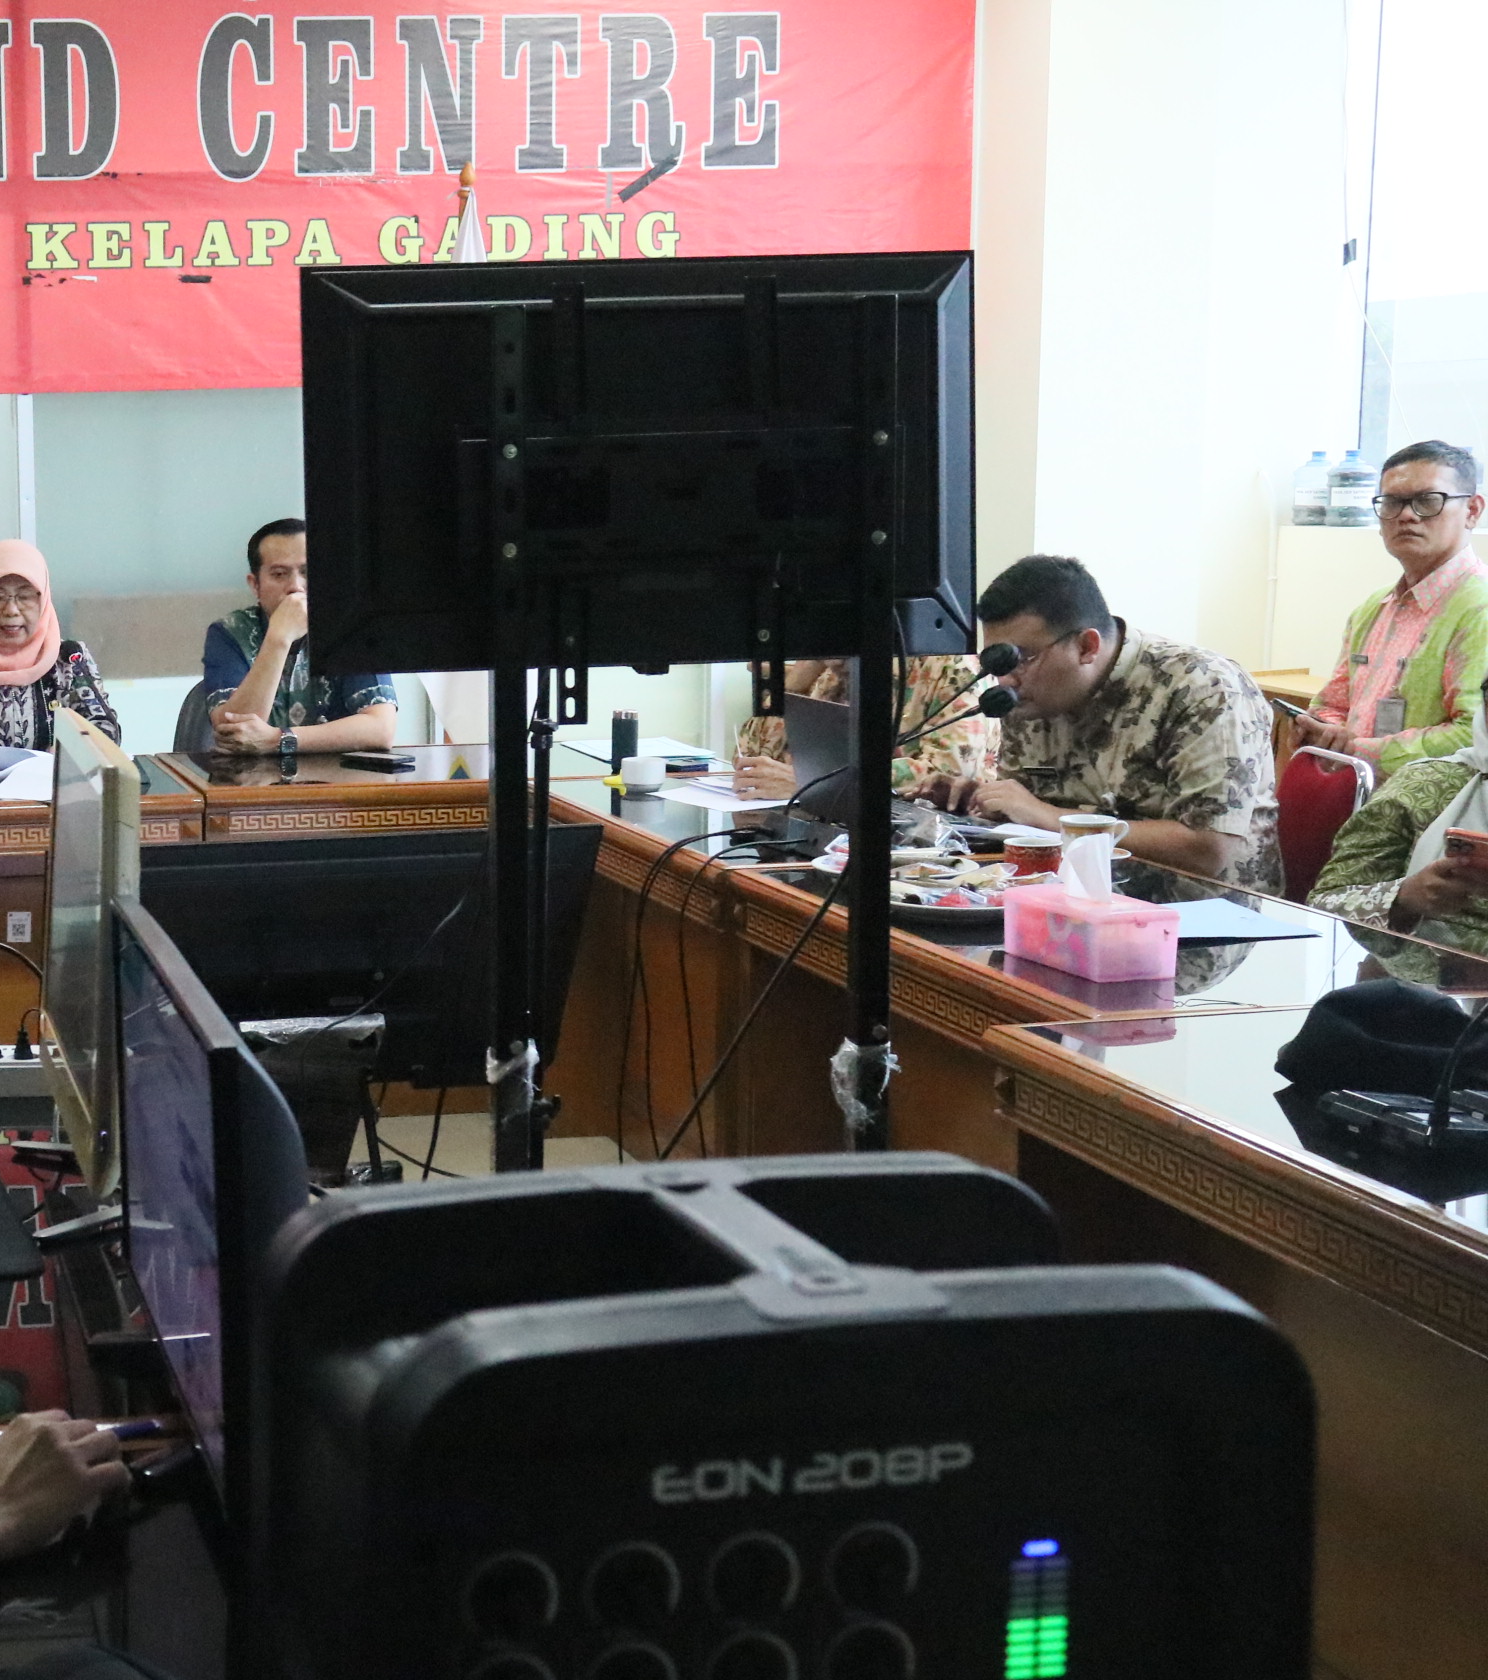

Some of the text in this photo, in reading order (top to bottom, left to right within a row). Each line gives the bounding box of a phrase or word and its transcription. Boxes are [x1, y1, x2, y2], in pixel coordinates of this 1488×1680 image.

[197, 10, 783, 184] CENTRE
[26, 217, 342, 271] KELAPA
[378, 210, 681, 266] GADING
[651, 1442, 974, 1504] EON 208P
